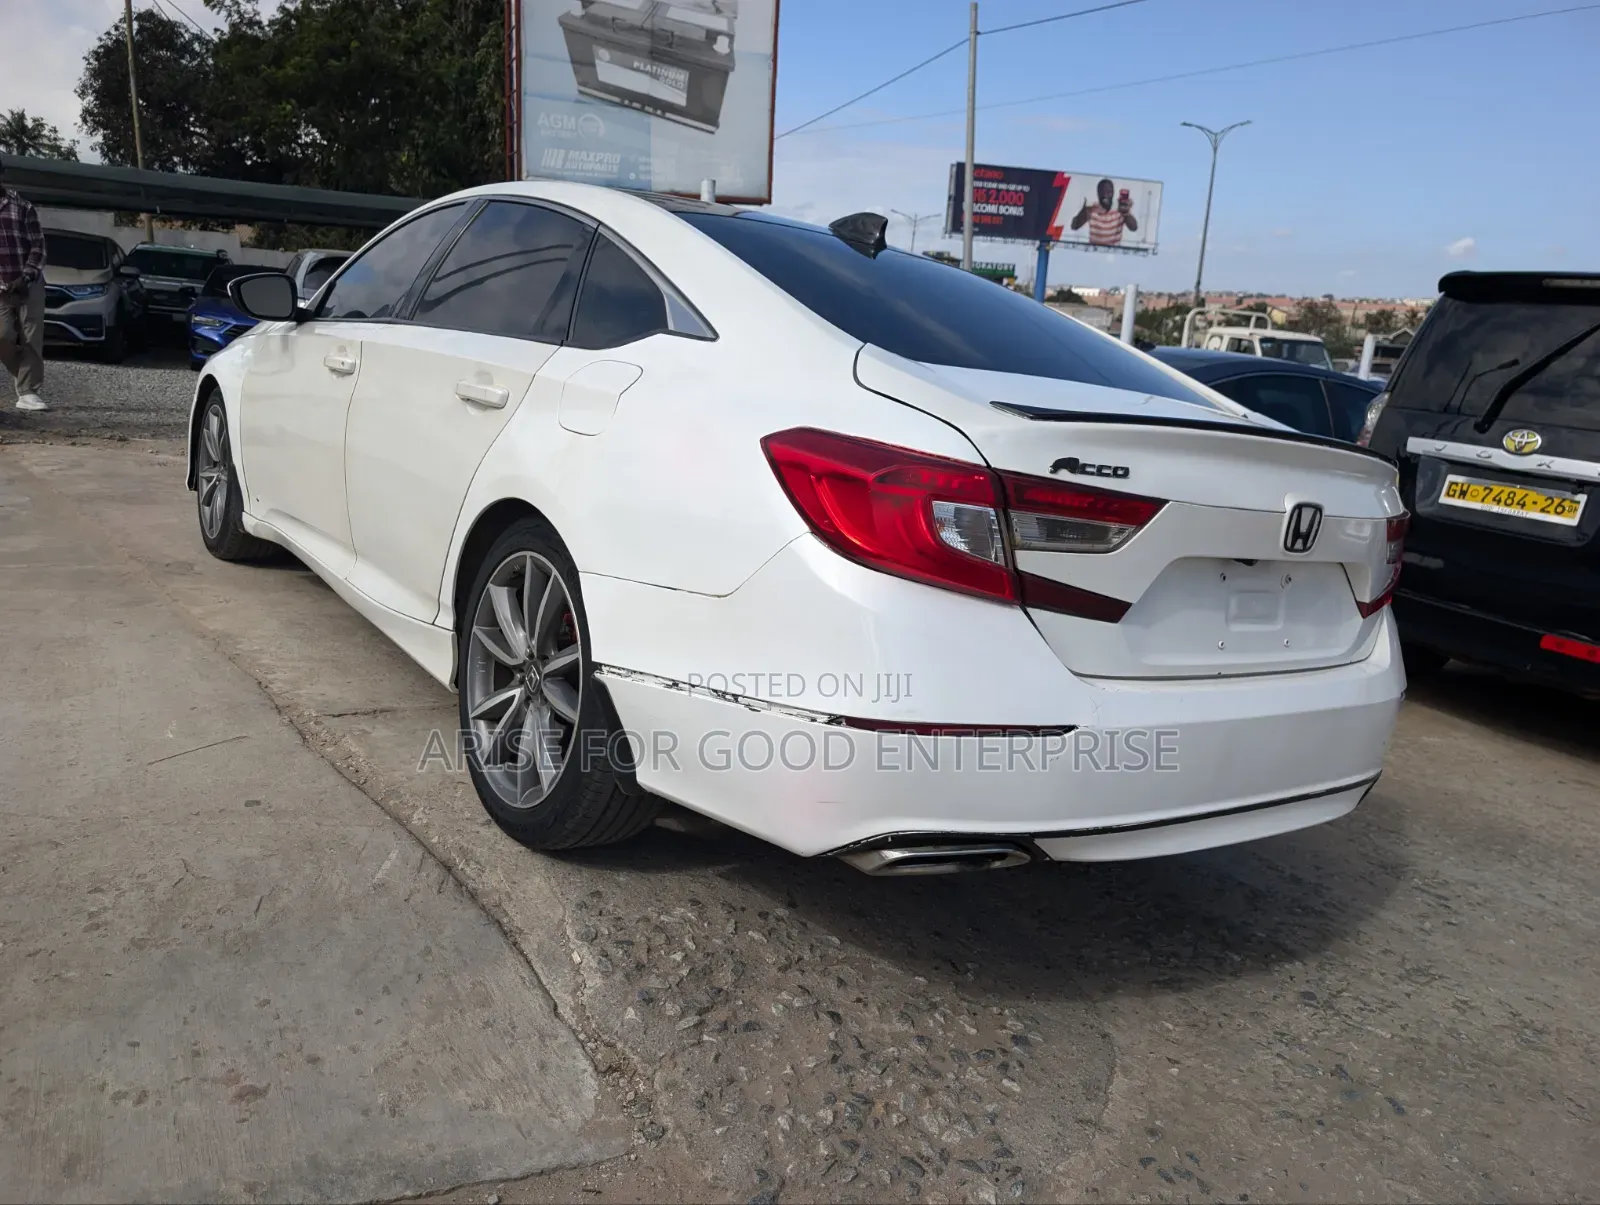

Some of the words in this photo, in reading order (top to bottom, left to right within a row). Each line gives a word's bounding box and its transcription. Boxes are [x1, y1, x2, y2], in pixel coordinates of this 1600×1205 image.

[633, 60, 686, 81] PLATINUM
[537, 112, 576, 131] AGM
[568, 150, 621, 164] MAXPRO
[989, 188, 1025, 206] 2,000
[999, 205, 1025, 217] BONUS
[1446, 483, 1471, 500] GW
